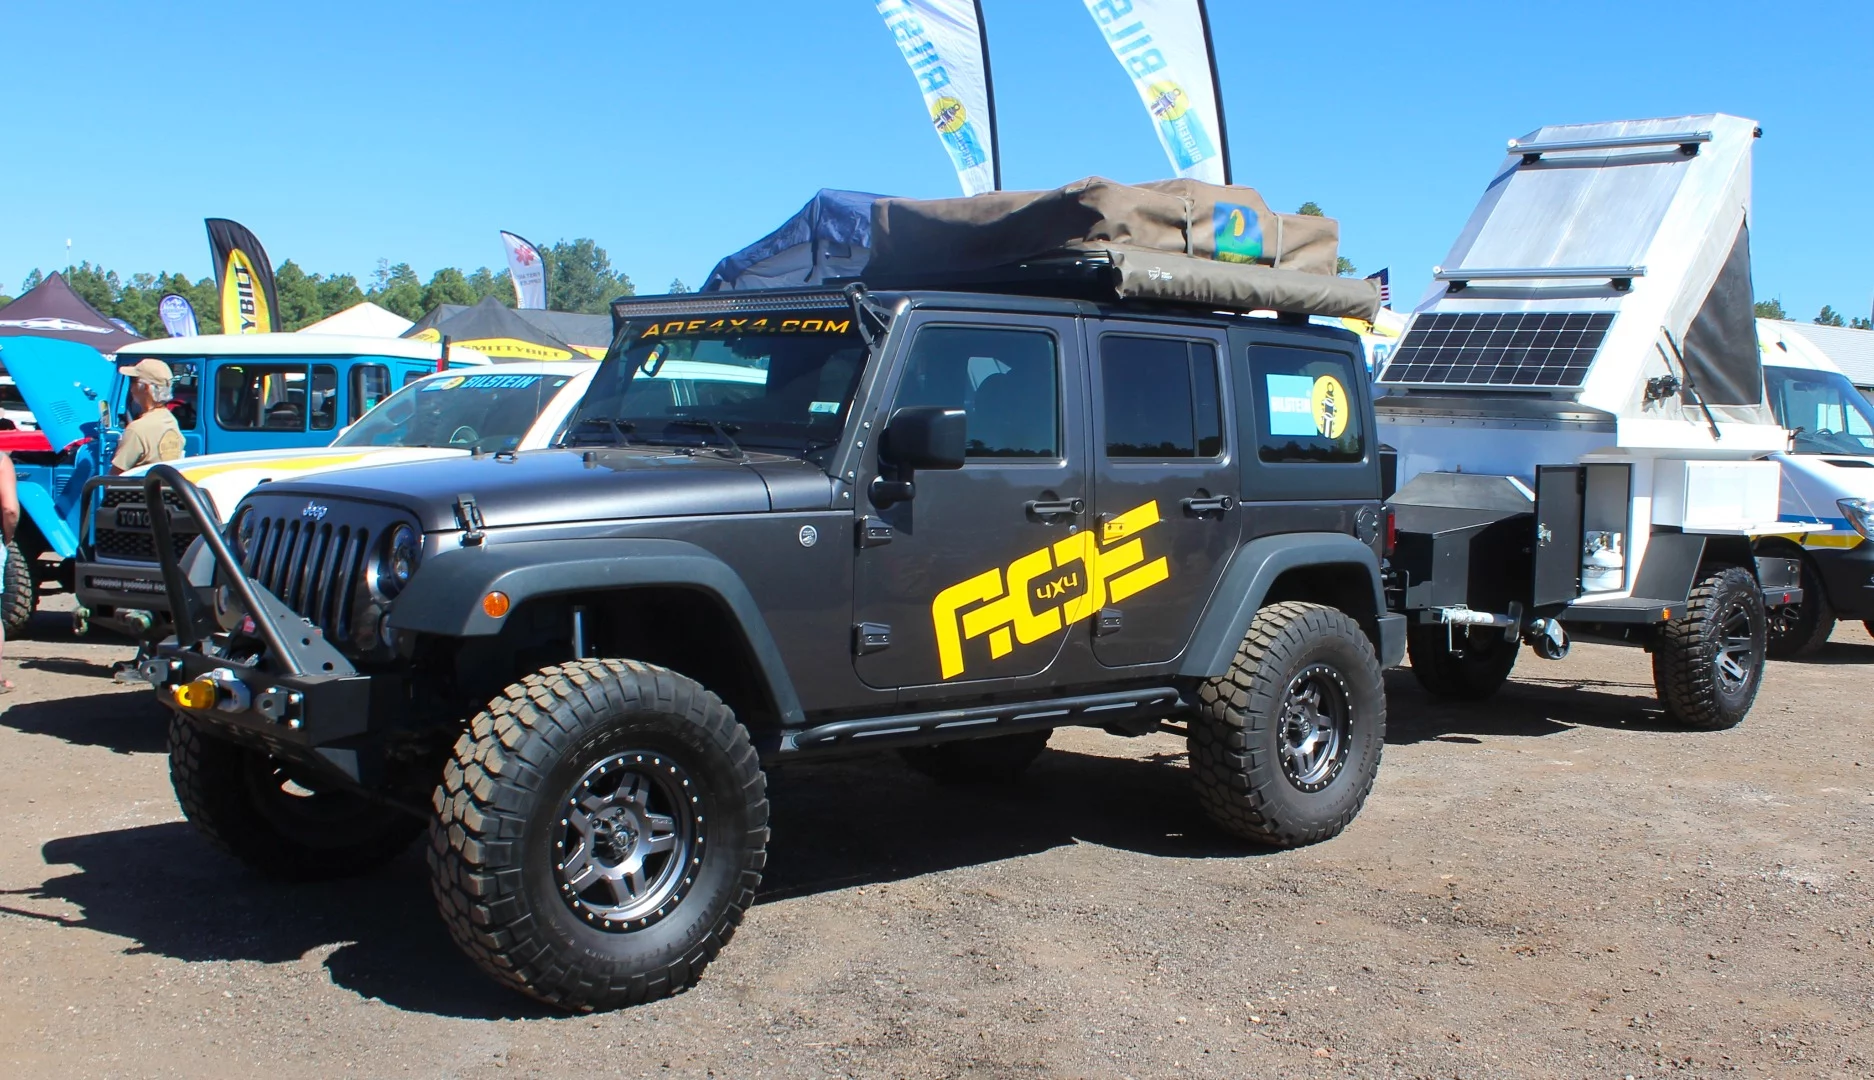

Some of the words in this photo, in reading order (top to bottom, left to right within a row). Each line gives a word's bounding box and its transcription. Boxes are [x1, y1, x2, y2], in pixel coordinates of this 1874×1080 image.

[233, 262, 256, 333] YBILT
[460, 376, 538, 389] BILSTEIN
[120, 511, 151, 526] TOYO
[303, 500, 328, 520] Jeep
